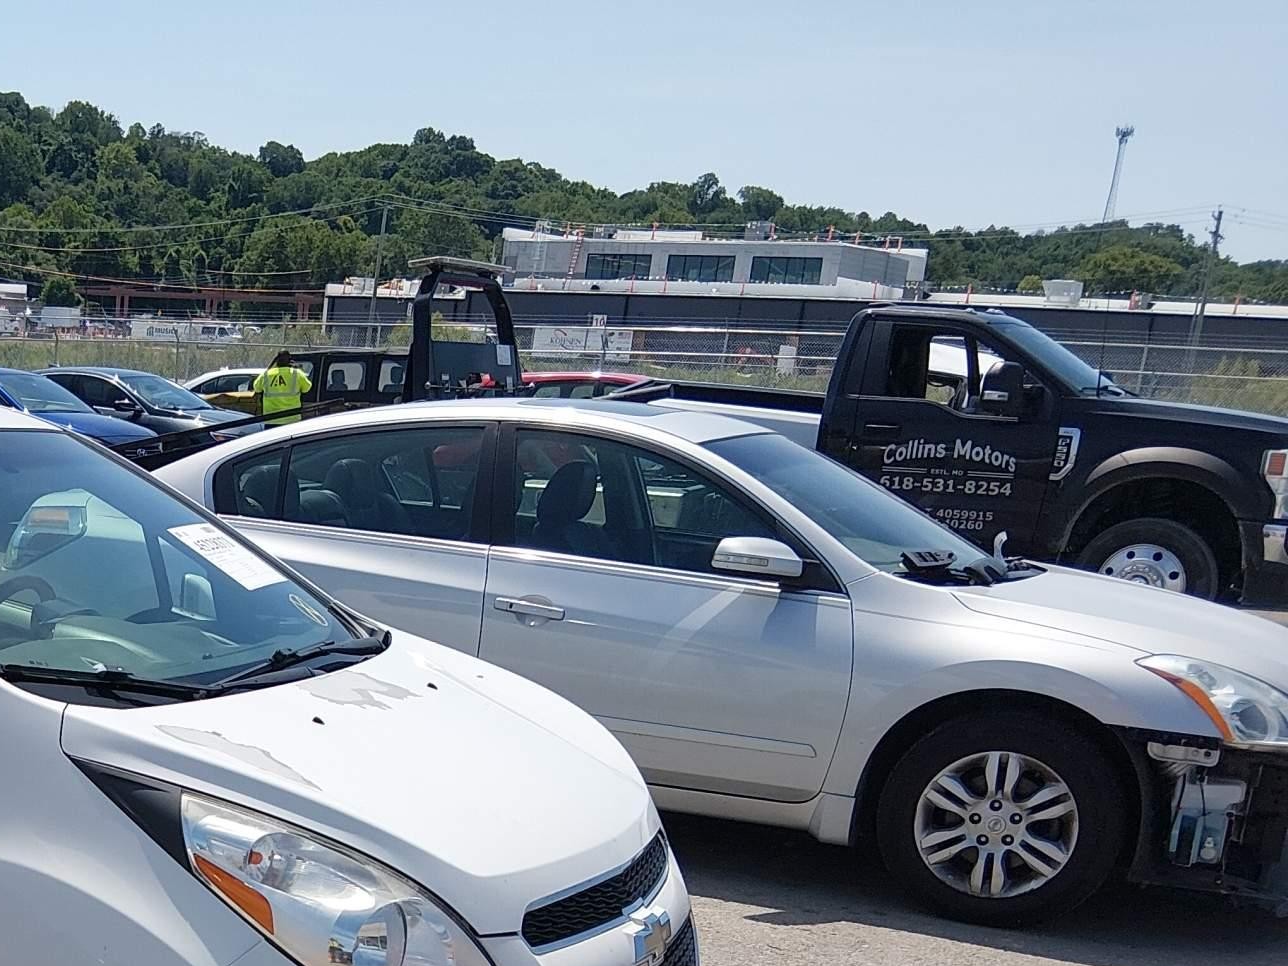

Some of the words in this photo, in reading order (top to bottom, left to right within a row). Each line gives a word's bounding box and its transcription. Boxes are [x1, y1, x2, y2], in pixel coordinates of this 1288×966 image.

[883, 438, 947, 464] Collins
[953, 438, 1017, 473] Motors
[879, 475, 1012, 497] 618-531-8254
[936, 509, 994, 521] 4059915
